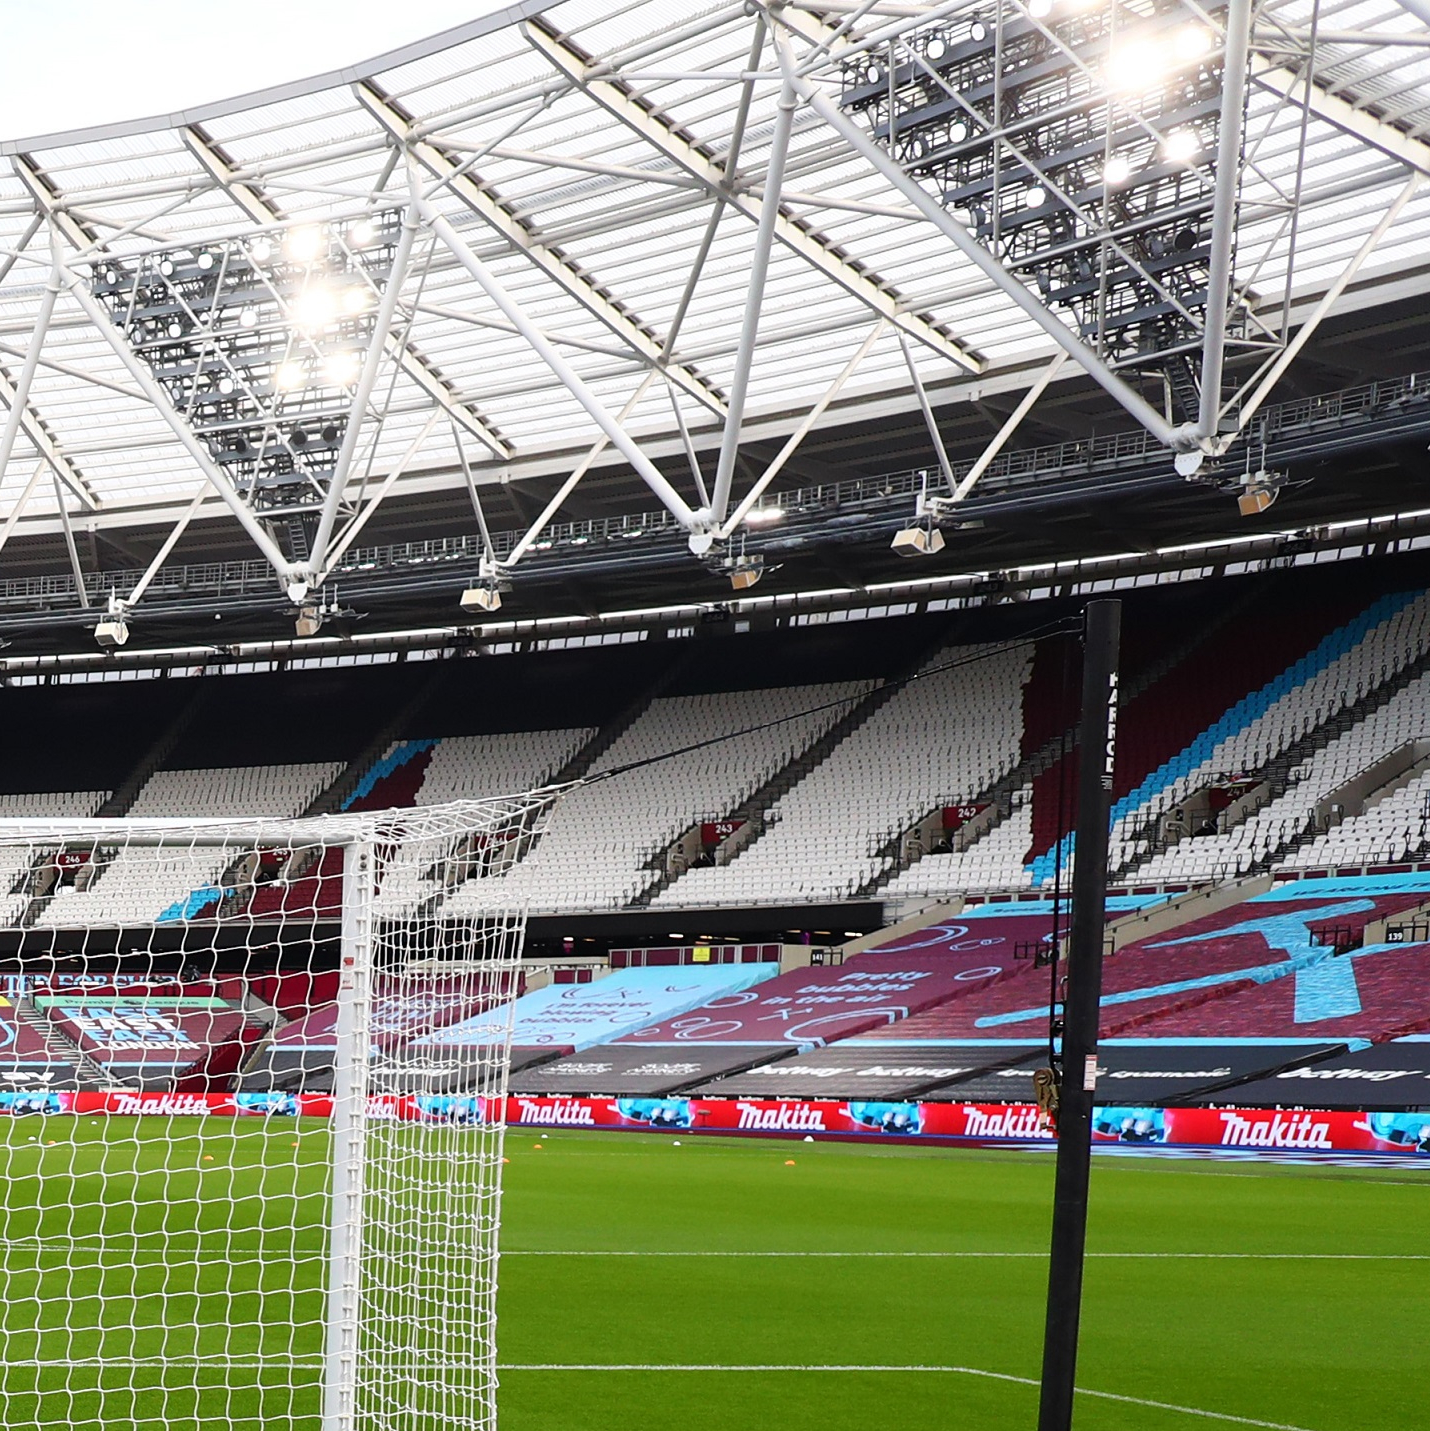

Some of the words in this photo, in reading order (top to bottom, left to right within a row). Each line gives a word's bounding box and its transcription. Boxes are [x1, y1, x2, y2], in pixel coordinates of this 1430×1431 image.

[957, 807, 977, 818] 242
[715, 824, 733, 834] 243
[65, 854, 81, 864] 246
[1387, 932, 1403, 942] 139
[812, 953, 823, 961] 141
[59, 1007, 161, 1018] EAST
[71, 1018, 176, 1030] EAST
[84, 1030, 190, 1041] EAST
[95, 1041, 201, 1050] LONDON
[1277, 1066, 1423, 1081] betway
